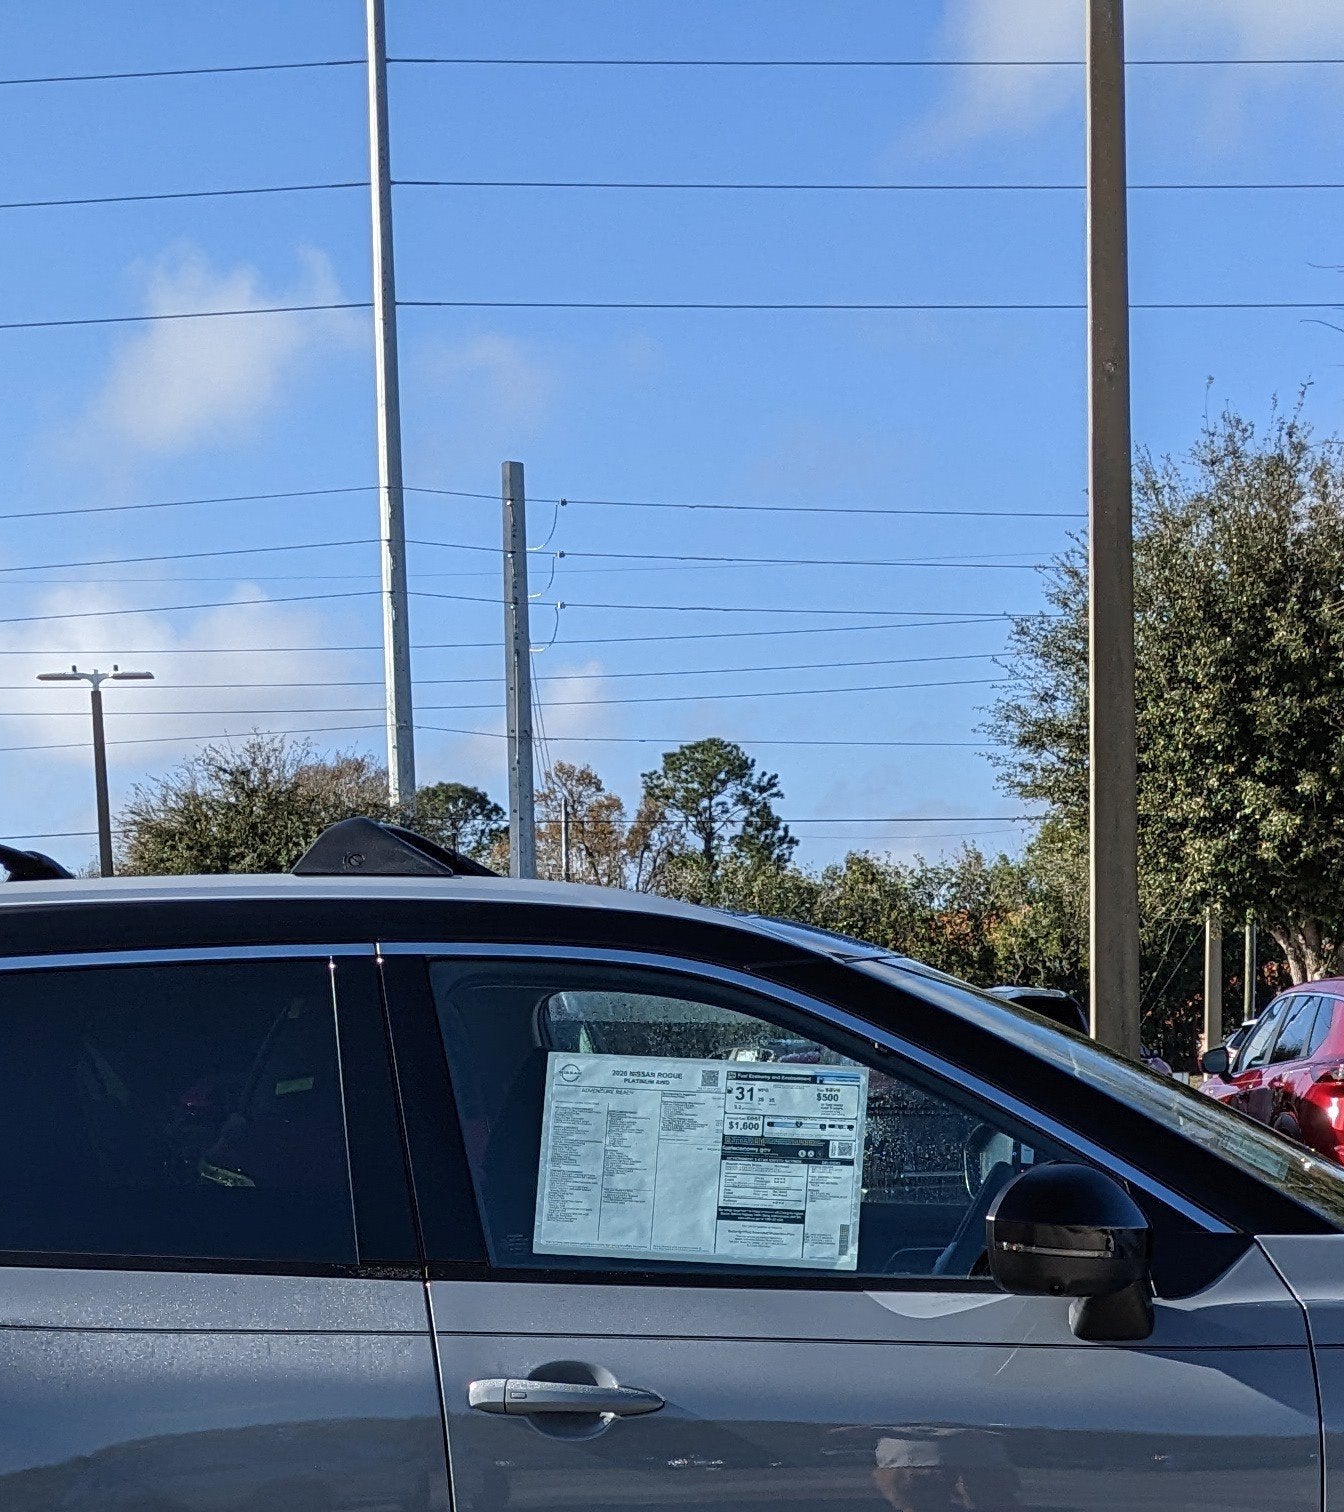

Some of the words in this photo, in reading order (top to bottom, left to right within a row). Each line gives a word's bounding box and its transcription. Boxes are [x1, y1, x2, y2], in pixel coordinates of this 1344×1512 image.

[657, 1072, 683, 1080] ROGUE
[735, 1086, 754, 1102] 31
[816, 1093, 839, 1102] $500
[728, 1121, 759, 1131] $1,600
